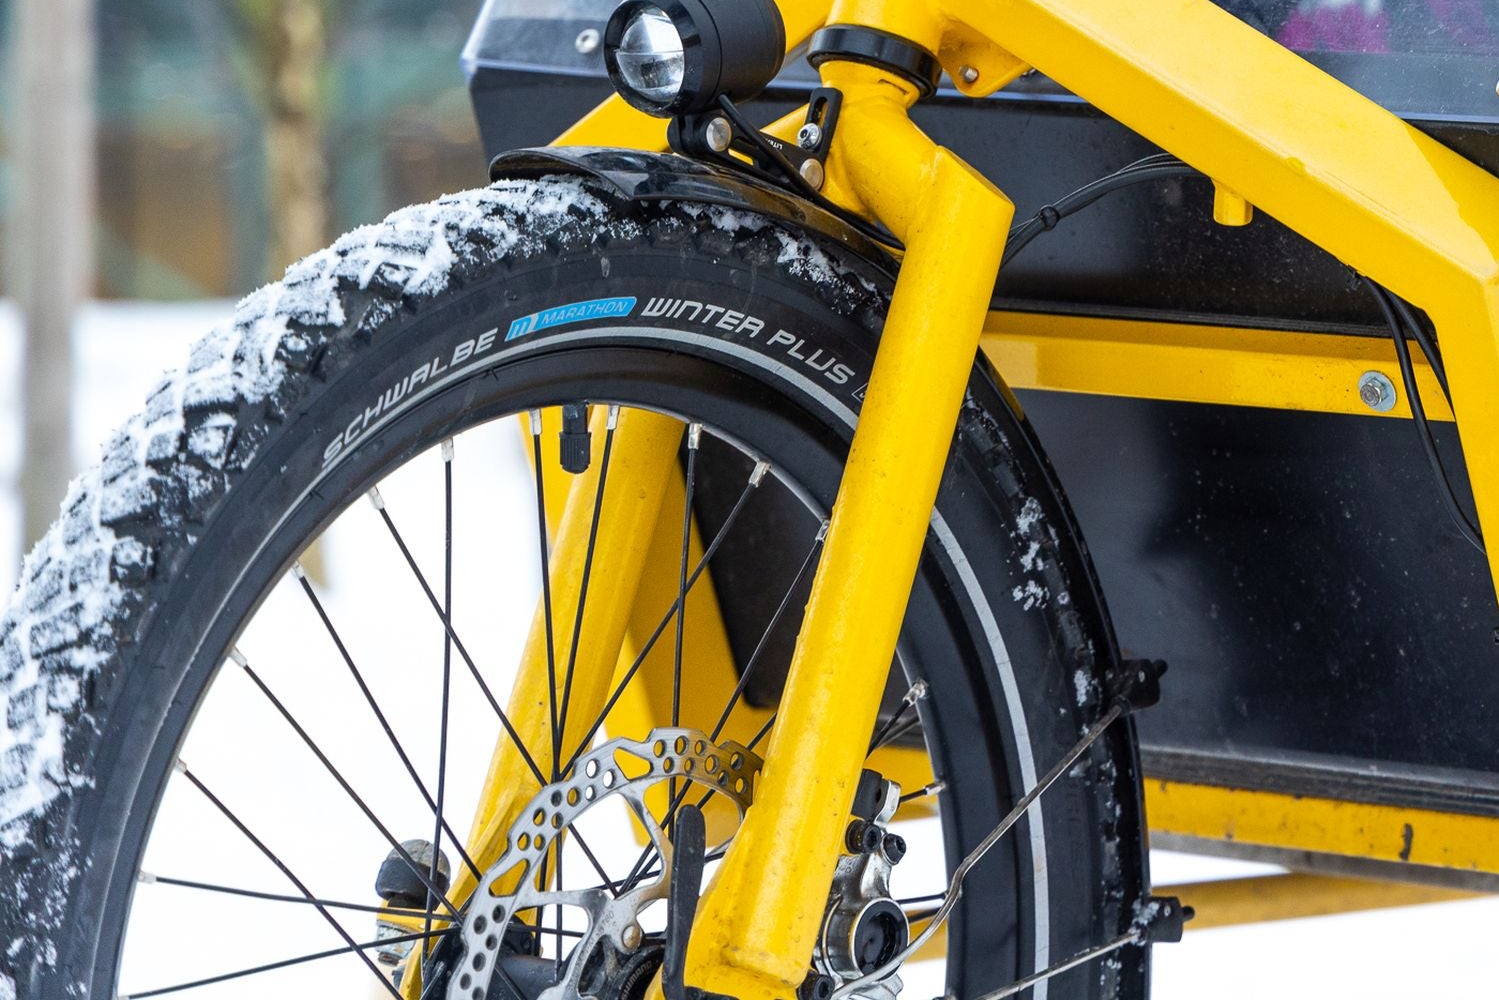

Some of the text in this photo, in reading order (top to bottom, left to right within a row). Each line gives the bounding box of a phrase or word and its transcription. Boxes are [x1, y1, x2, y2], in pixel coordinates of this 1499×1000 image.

[323, 297, 855, 462] SCHWALBE MARATHON WINTER PLUS
